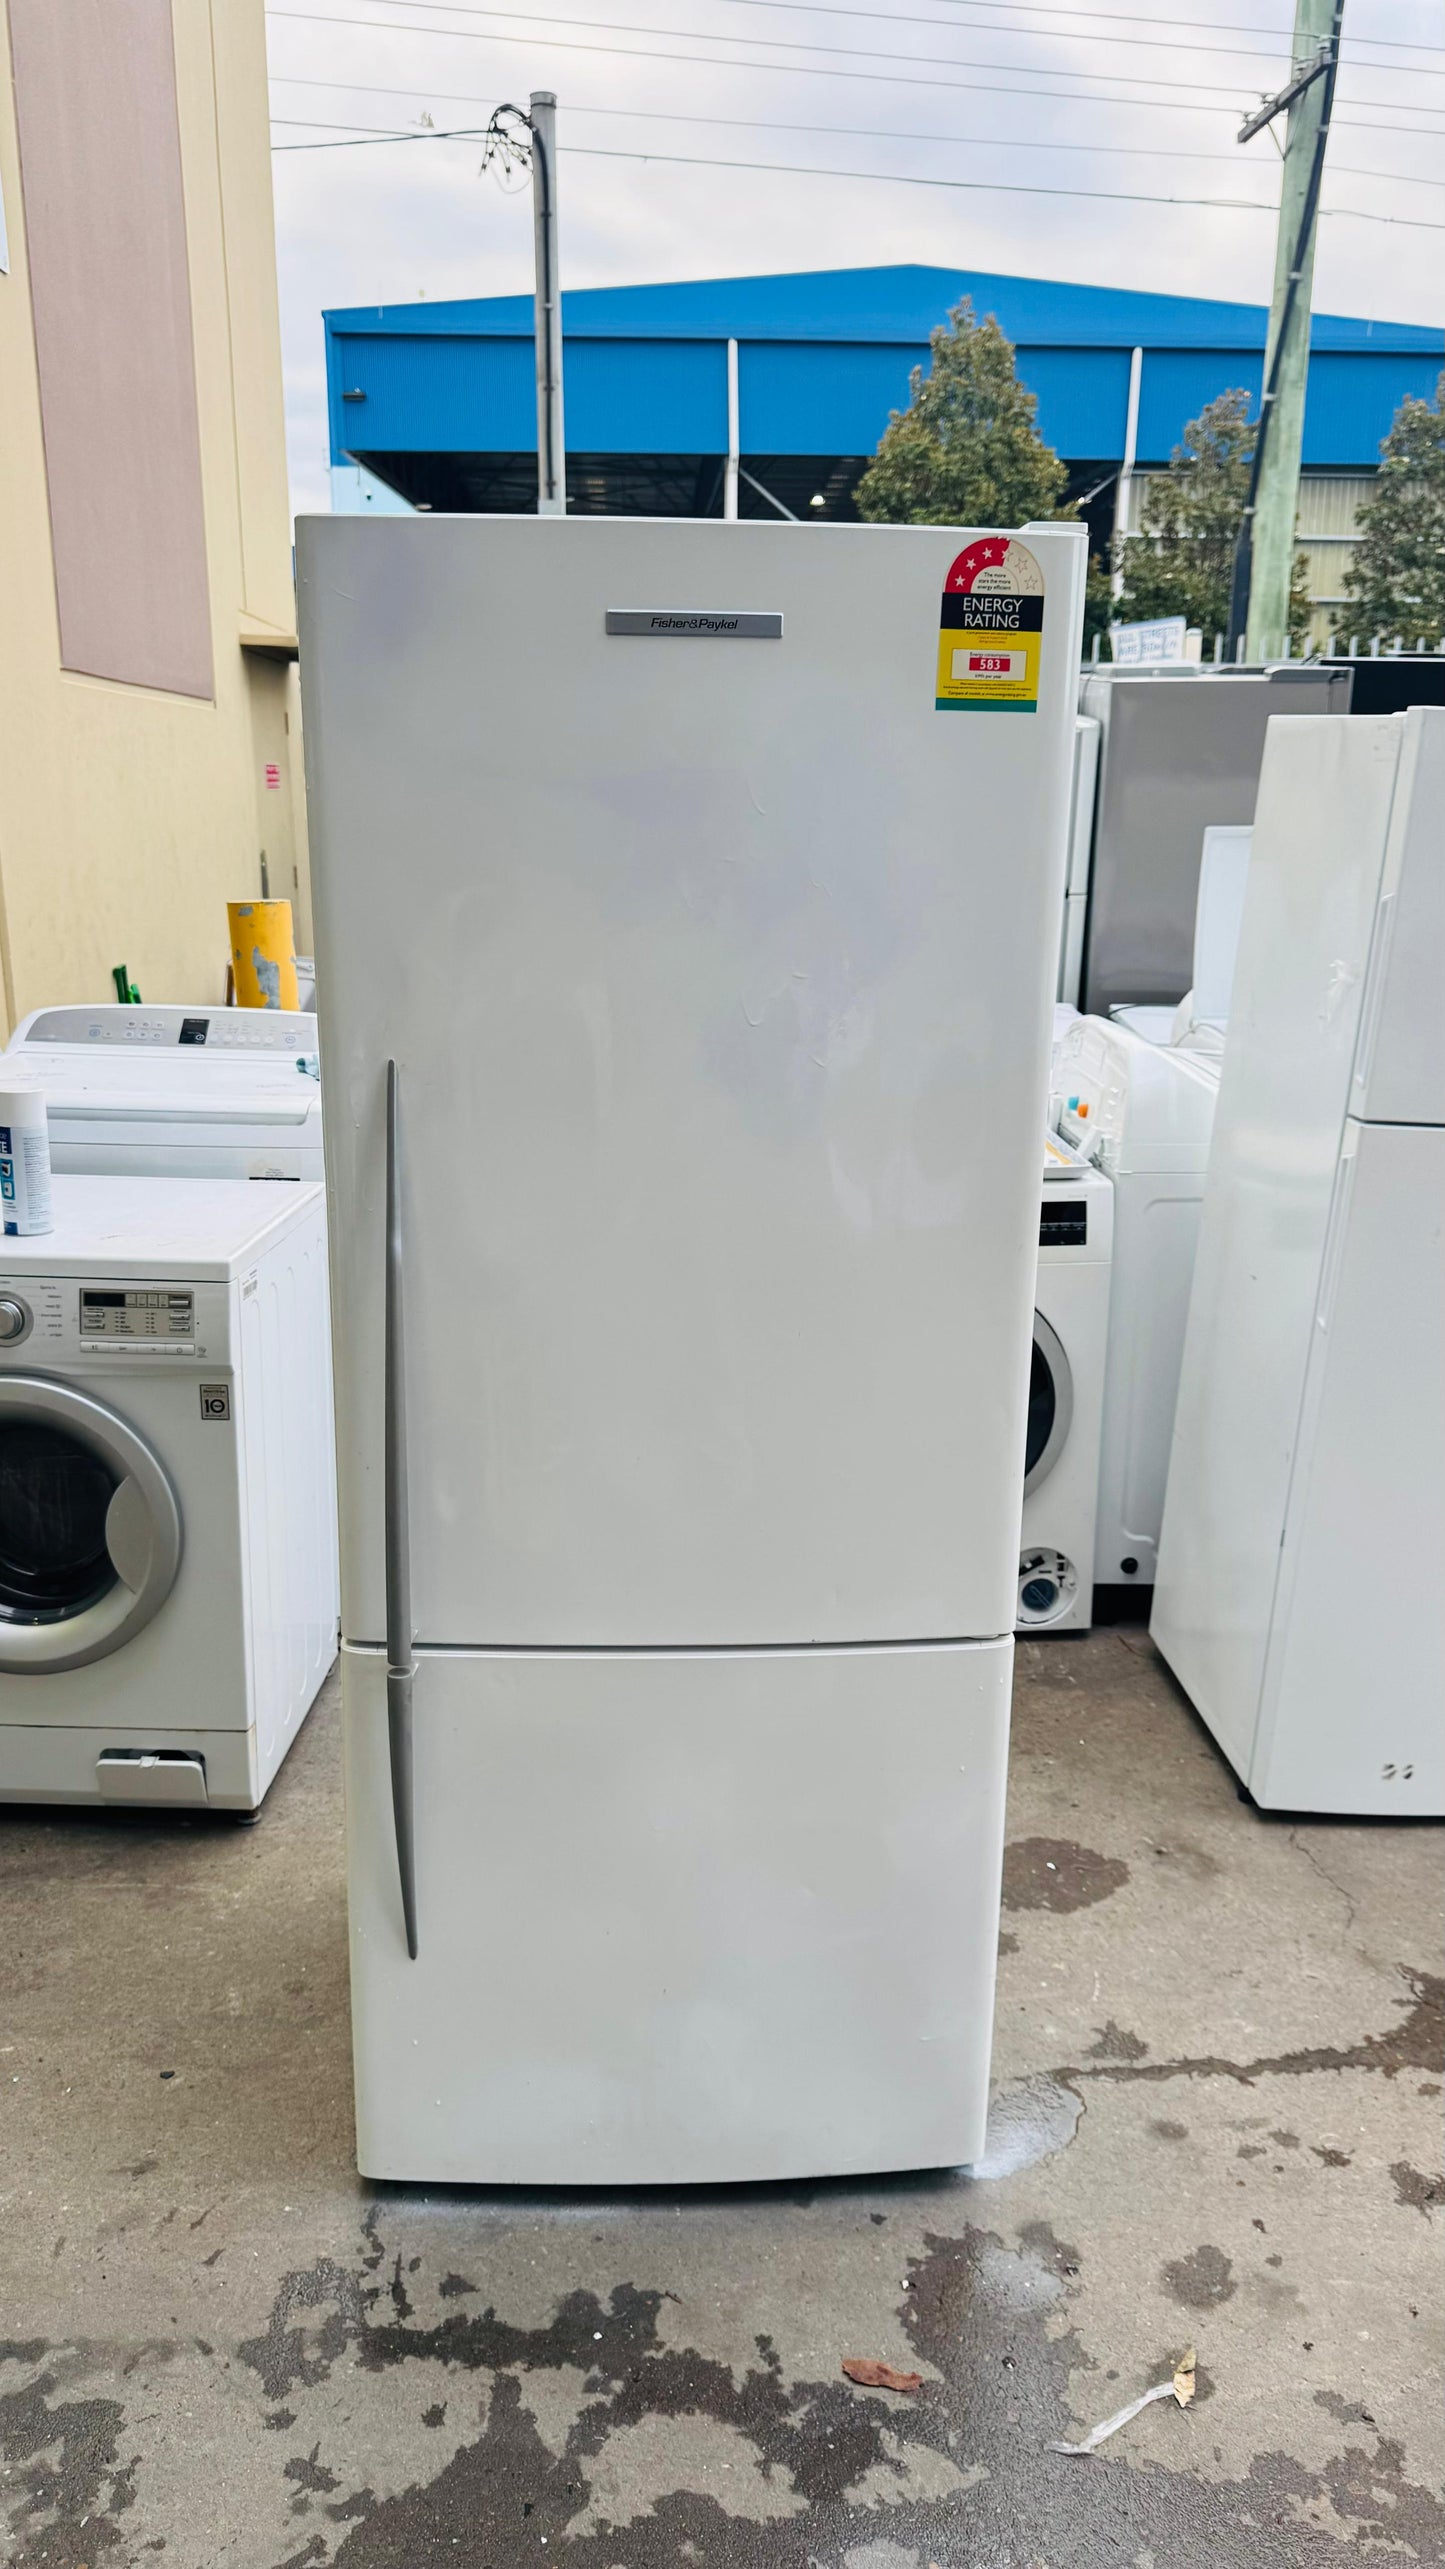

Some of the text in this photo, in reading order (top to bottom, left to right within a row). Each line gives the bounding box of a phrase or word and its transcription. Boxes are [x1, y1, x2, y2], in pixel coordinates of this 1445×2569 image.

[963, 597, 1023, 613] ENERGY
[651, 617, 739, 632] Fisher&Paykel
[964, 613, 1020, 628] RATING
[980, 659, 1001, 670] 583
